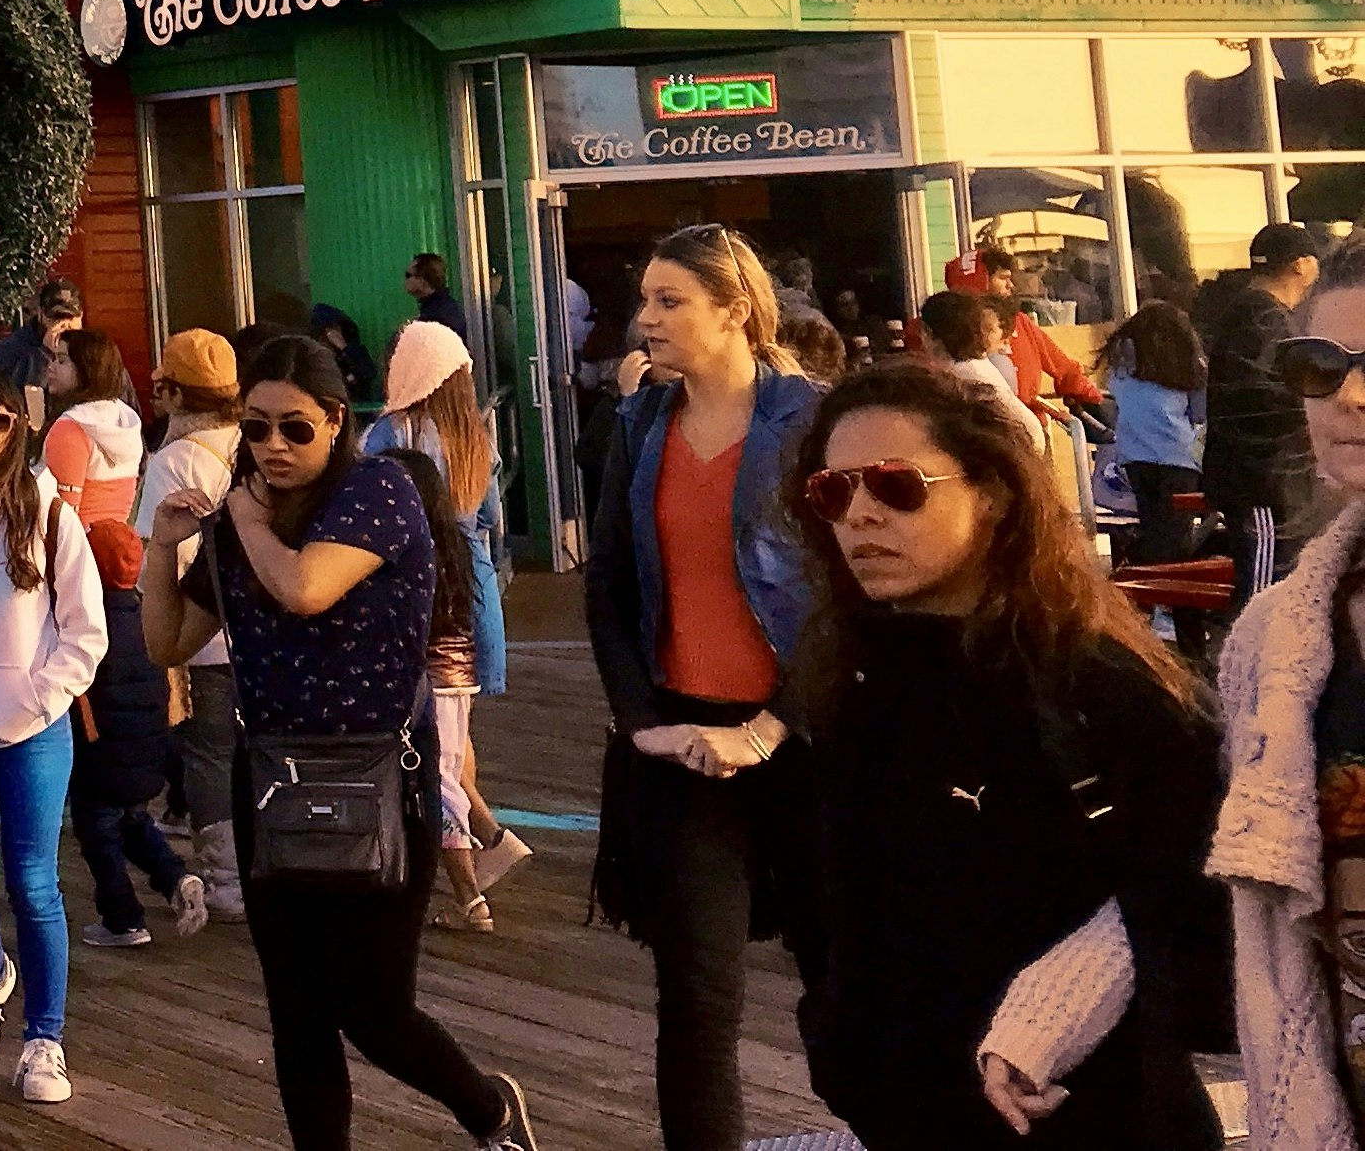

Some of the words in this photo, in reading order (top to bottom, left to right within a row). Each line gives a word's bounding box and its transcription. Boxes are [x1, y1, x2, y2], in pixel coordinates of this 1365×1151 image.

[660, 80, 773, 114] OPEN
[571, 132, 635, 166] The
[642, 125, 752, 157] Coffee
[757, 120, 867, 153] Bean
